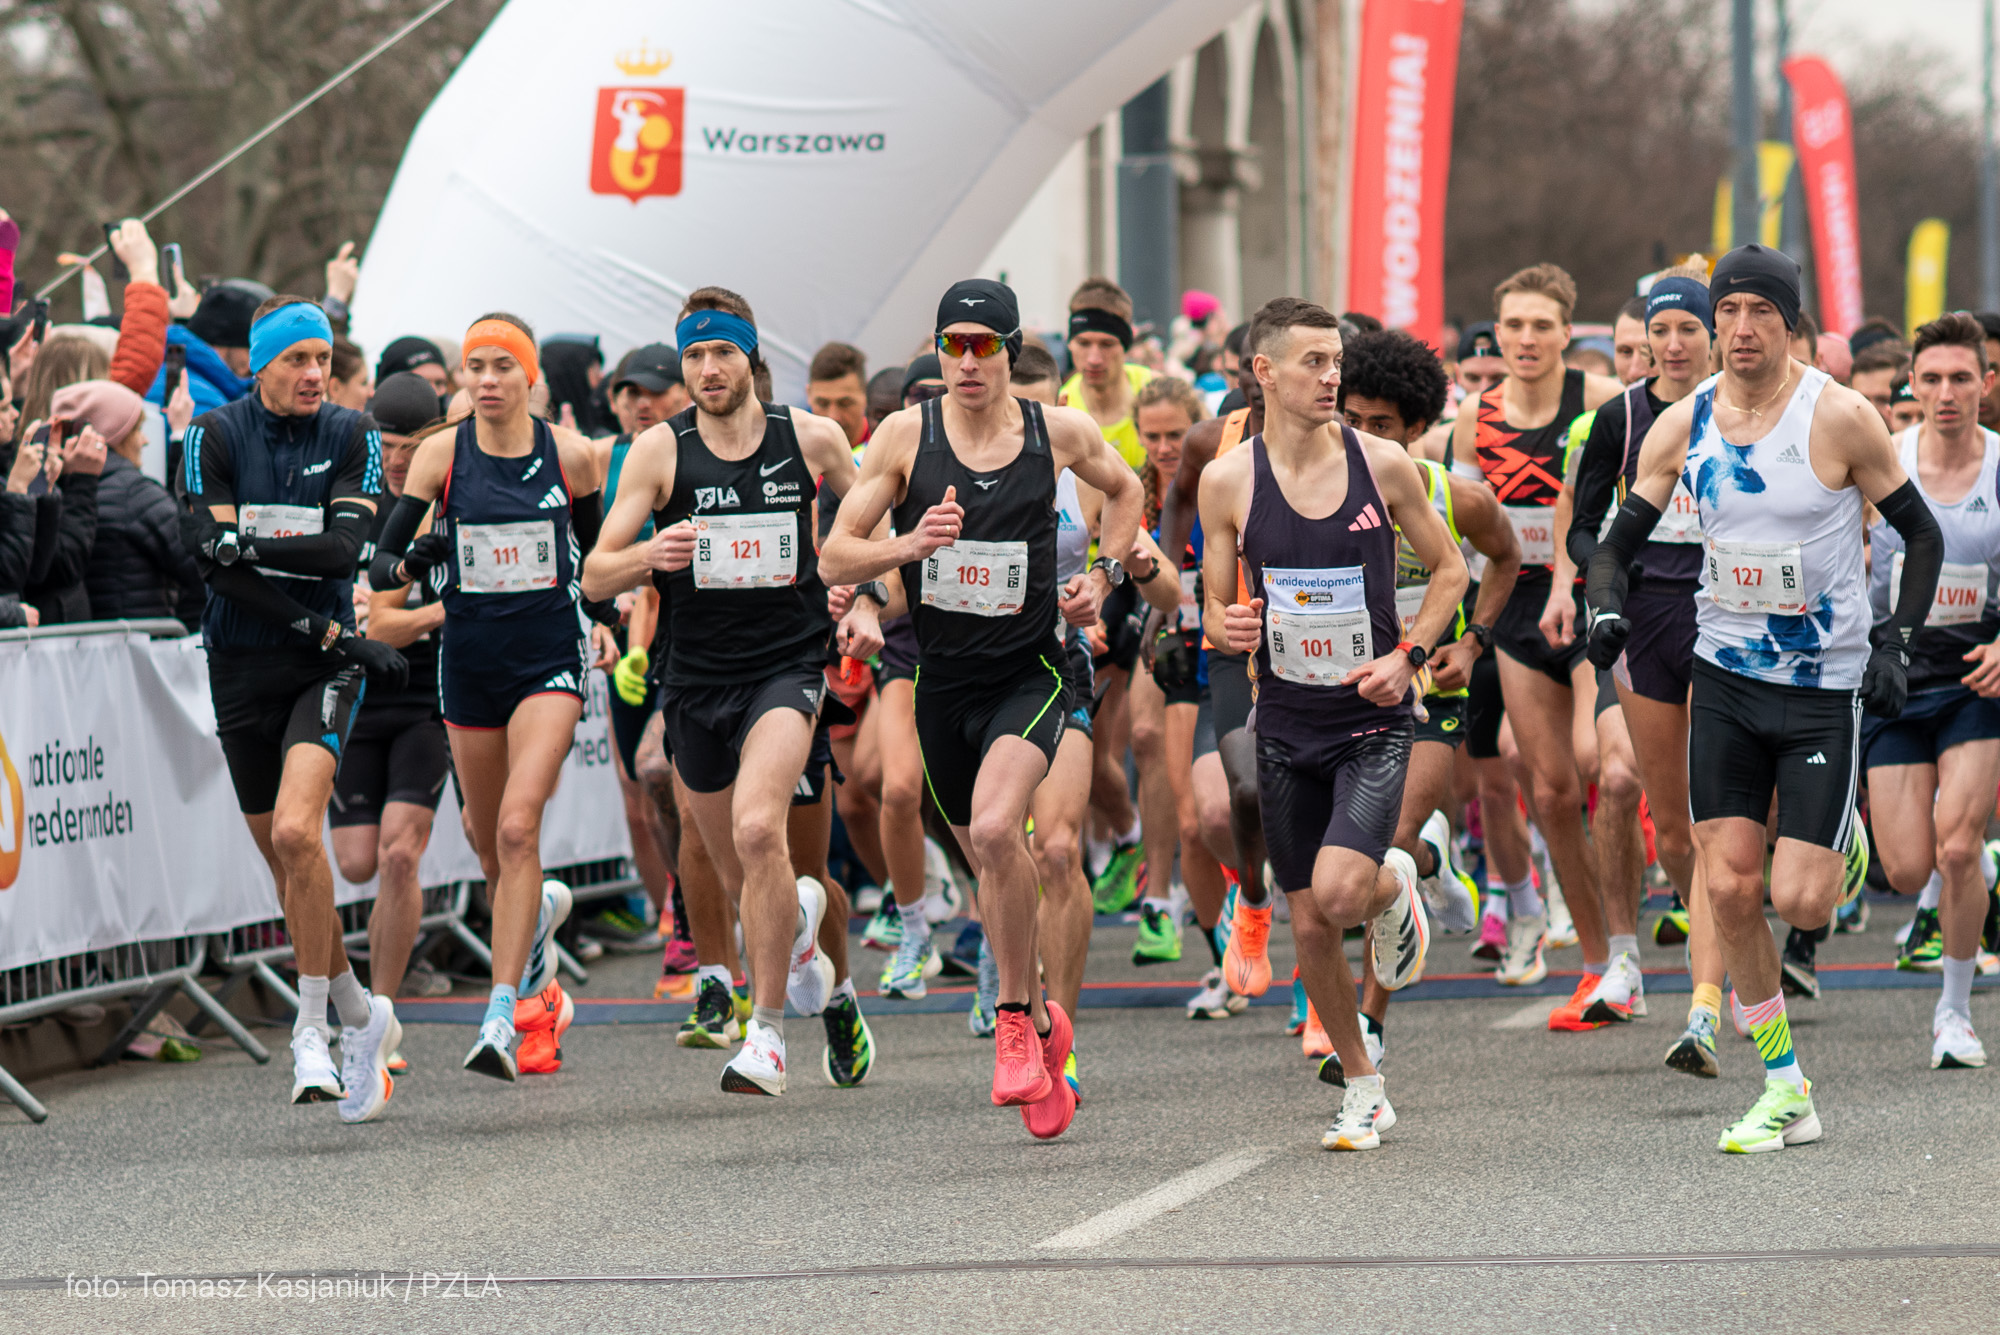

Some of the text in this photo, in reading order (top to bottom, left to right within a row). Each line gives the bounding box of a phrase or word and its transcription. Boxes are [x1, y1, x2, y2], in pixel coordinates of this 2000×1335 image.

[702, 127, 886, 153] Warszawa
[1776, 456, 1806, 465] adidas
[778, 484, 800, 492] OPOLE
[1674, 496, 1699, 514] 11
[1522, 528, 1548, 542] 102
[493, 546, 519, 565] 111
[730, 540, 761, 559] 121
[957, 565, 990, 586] 103
[1275, 574, 1364, 589] unidevelopment
[1732, 566, 1763, 586] 127
[1301, 638, 1333, 657] 101
